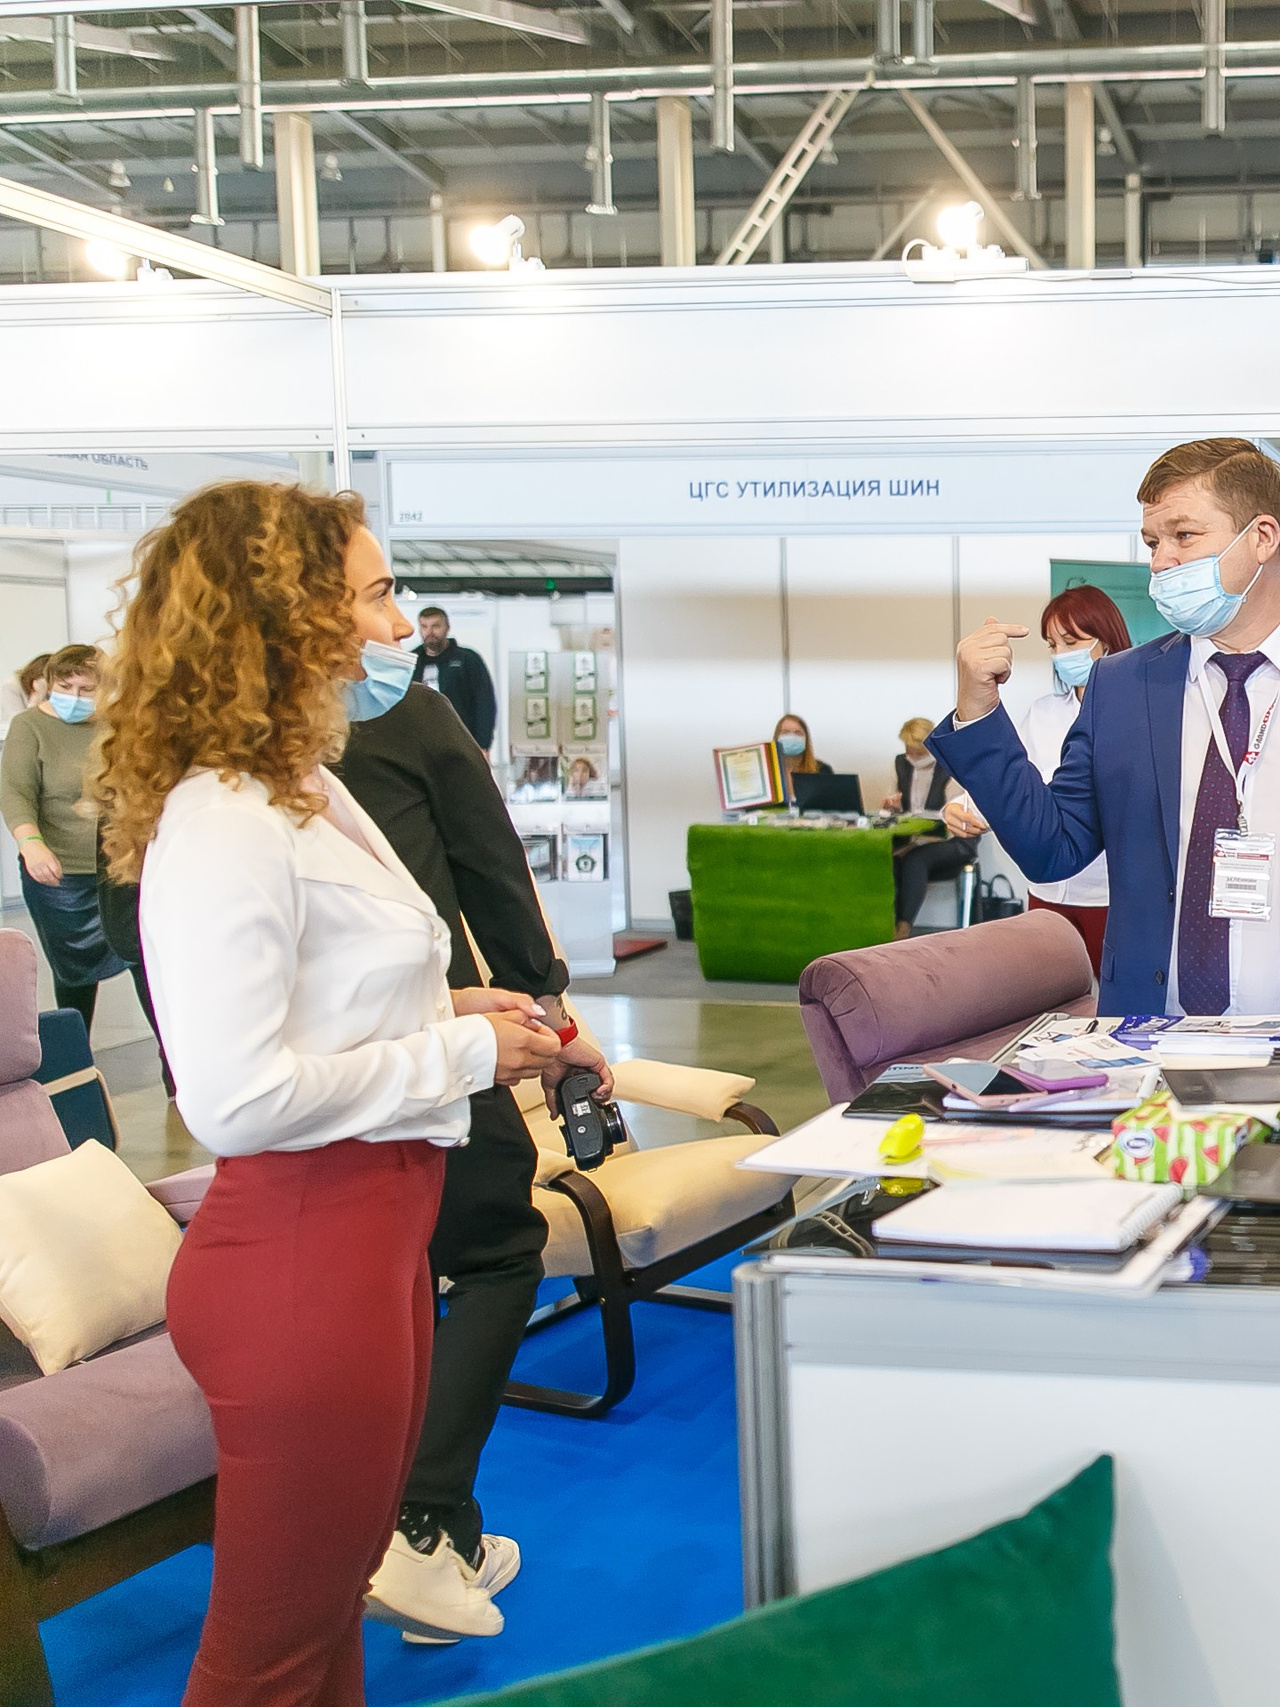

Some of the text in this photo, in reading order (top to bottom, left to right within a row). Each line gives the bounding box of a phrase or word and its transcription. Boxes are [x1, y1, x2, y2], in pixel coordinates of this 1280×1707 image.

[689, 479, 940, 501] ЦГС УТИЛИЗАЦИЯ ШИН
